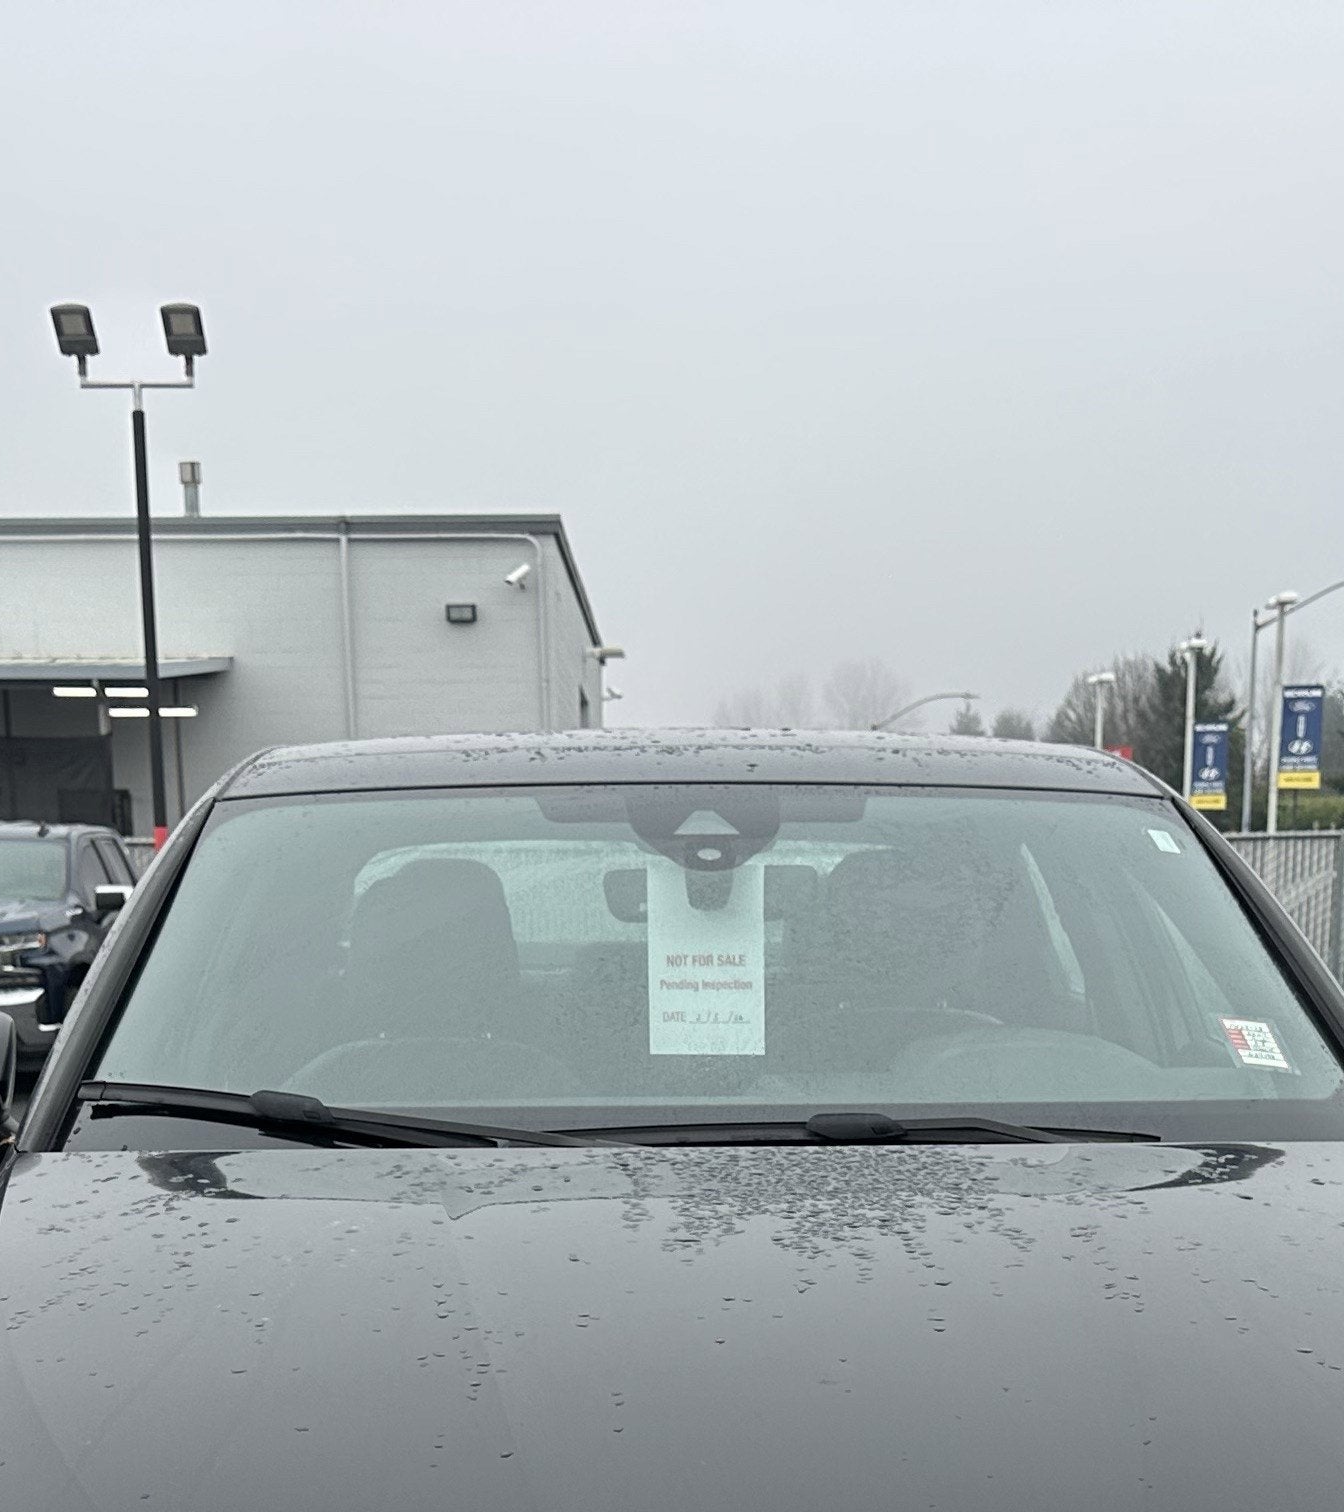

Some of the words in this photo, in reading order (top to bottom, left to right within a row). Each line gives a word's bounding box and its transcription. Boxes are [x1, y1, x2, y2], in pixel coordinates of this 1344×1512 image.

[666, 954, 688, 967] NOT
[692, 954, 713, 967] FOR
[717, 954, 746, 967] SALE
[660, 980, 699, 992] Pending
[701, 980, 753, 991] Inspection
[662, 1011, 687, 1023] DATE
